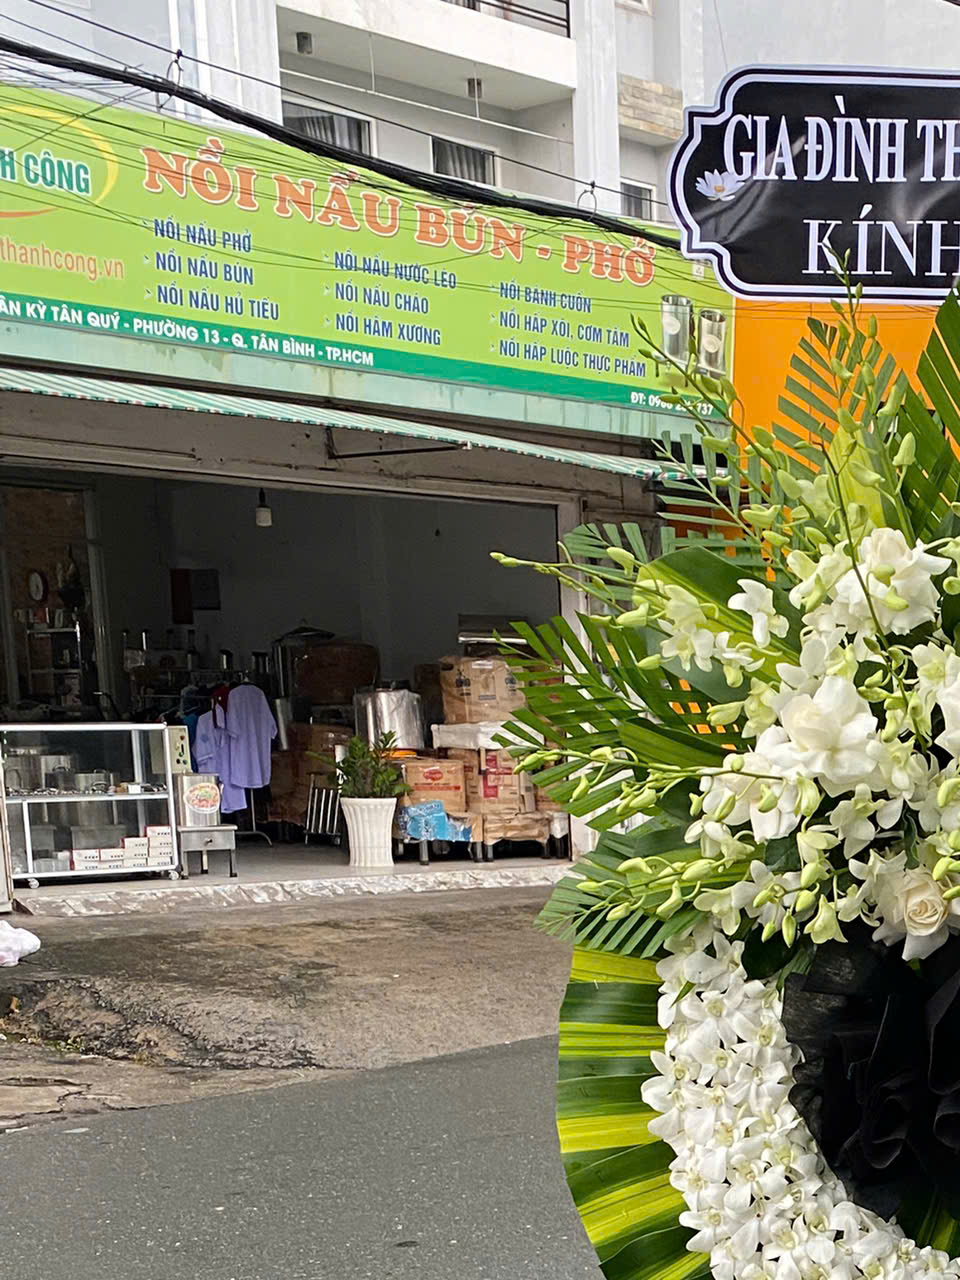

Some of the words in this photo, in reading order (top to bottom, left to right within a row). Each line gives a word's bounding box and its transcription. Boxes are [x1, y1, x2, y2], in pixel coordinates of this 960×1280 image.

[723, 114, 798, 181] GIA
[803, 95, 909, 184] ĐÌNH
[23, 151, 91, 194] CÔNG
[140, 136, 260, 212] NỒI
[560, 235, 657, 287] PHỞ
[154, 214, 181, 241] NỒI
[185, 220, 217, 247] NẤU
[221, 228, 252, 253] PHỞ
[155, 247, 182, 274] NỒI
[187, 252, 218, 280] NẤU
[223, 261, 254, 286] BÚN
[157, 280, 184, 306] NỒI
[188, 285, 220, 312] NẤU
[224, 291, 244, 316] HỦ
[51, 304, 83, 325] TÂN
[133, 318, 199, 342] PHƯỜNG
[203, 328, 220, 345] 13
[231, 332, 248, 349] Q.
[251, 333, 280, 352] TÂN
[282, 337, 315, 358] BÌNH
[325, 345, 374, 367] TP.HCM
[397, 322, 441, 346] XƯƠNG
[577, 324, 602, 343] CƠM
